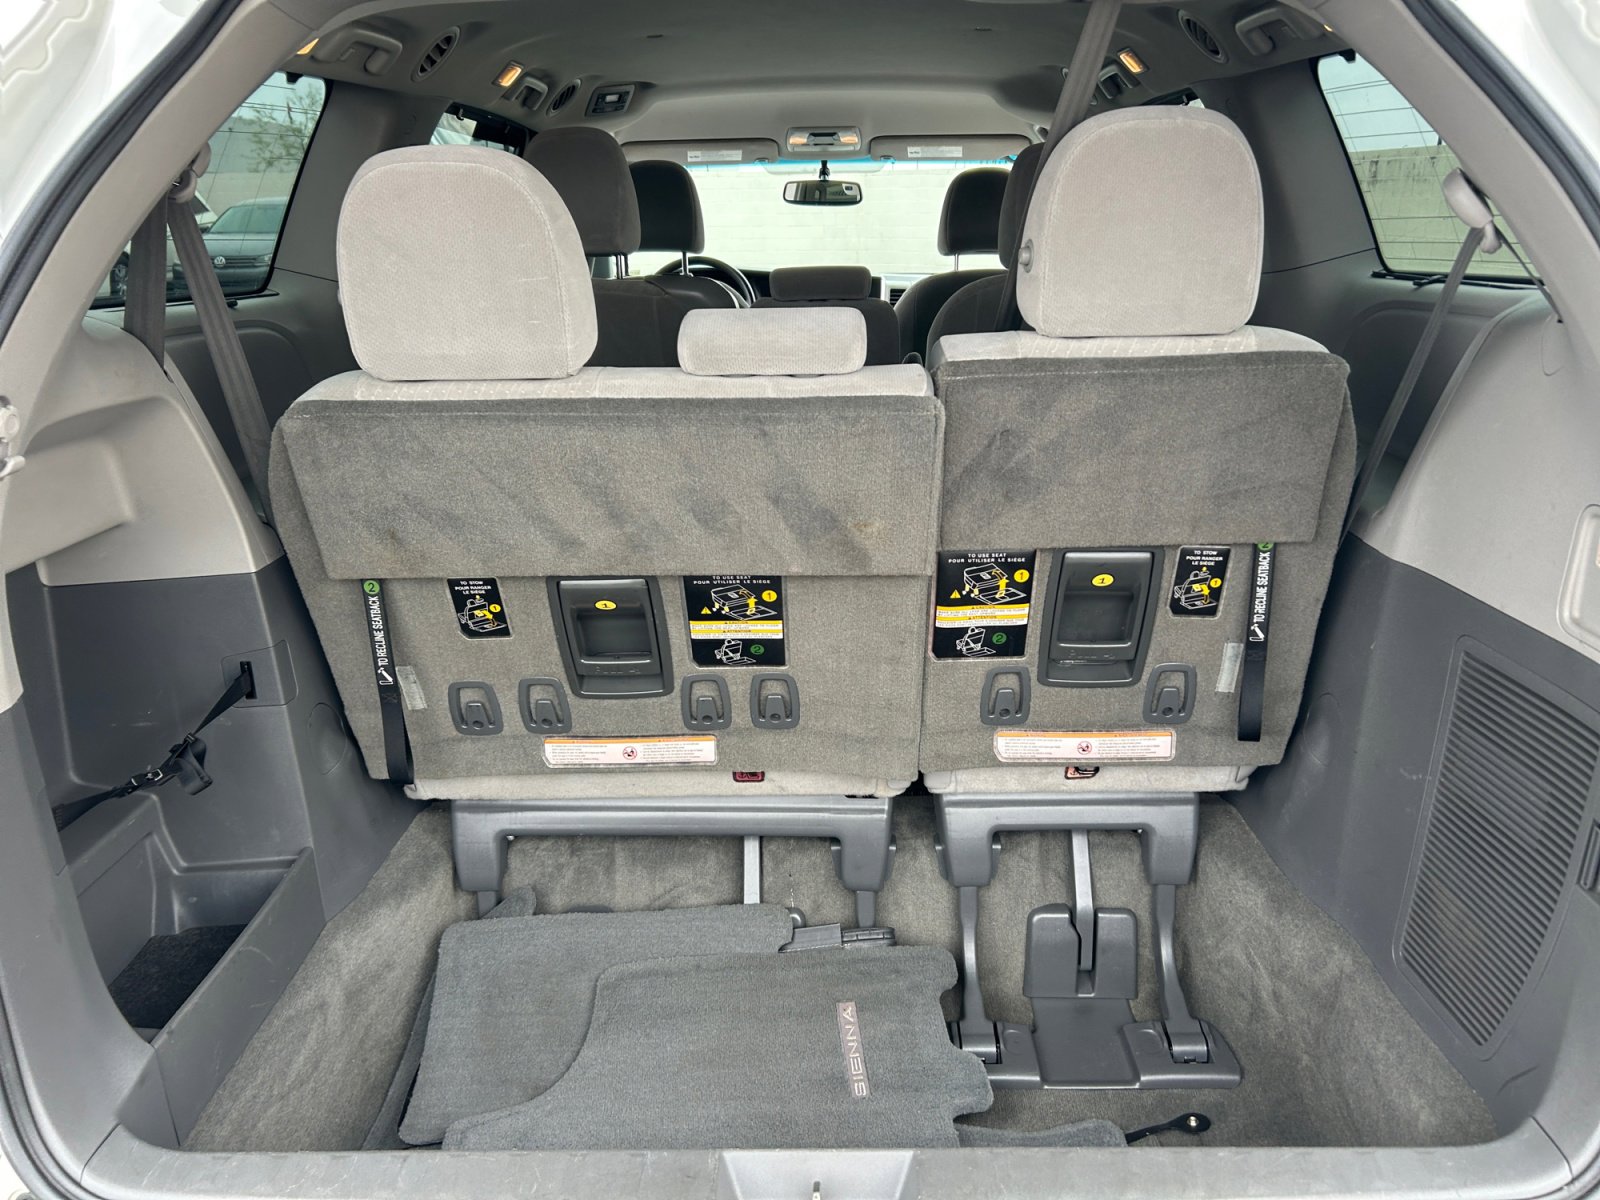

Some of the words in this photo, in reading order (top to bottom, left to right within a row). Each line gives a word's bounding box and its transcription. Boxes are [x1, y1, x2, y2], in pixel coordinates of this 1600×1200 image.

[1256, 551, 1271, 586] SEATBACK
[367, 595, 383, 630] SEATBACK
[1254, 586, 1267, 614] RECLINE
[1253, 614, 1266, 623] TO
[373, 630, 387, 657] RECLINE
[377, 658, 389, 666] TO
[842, 1006, 867, 1096] SIENNA
